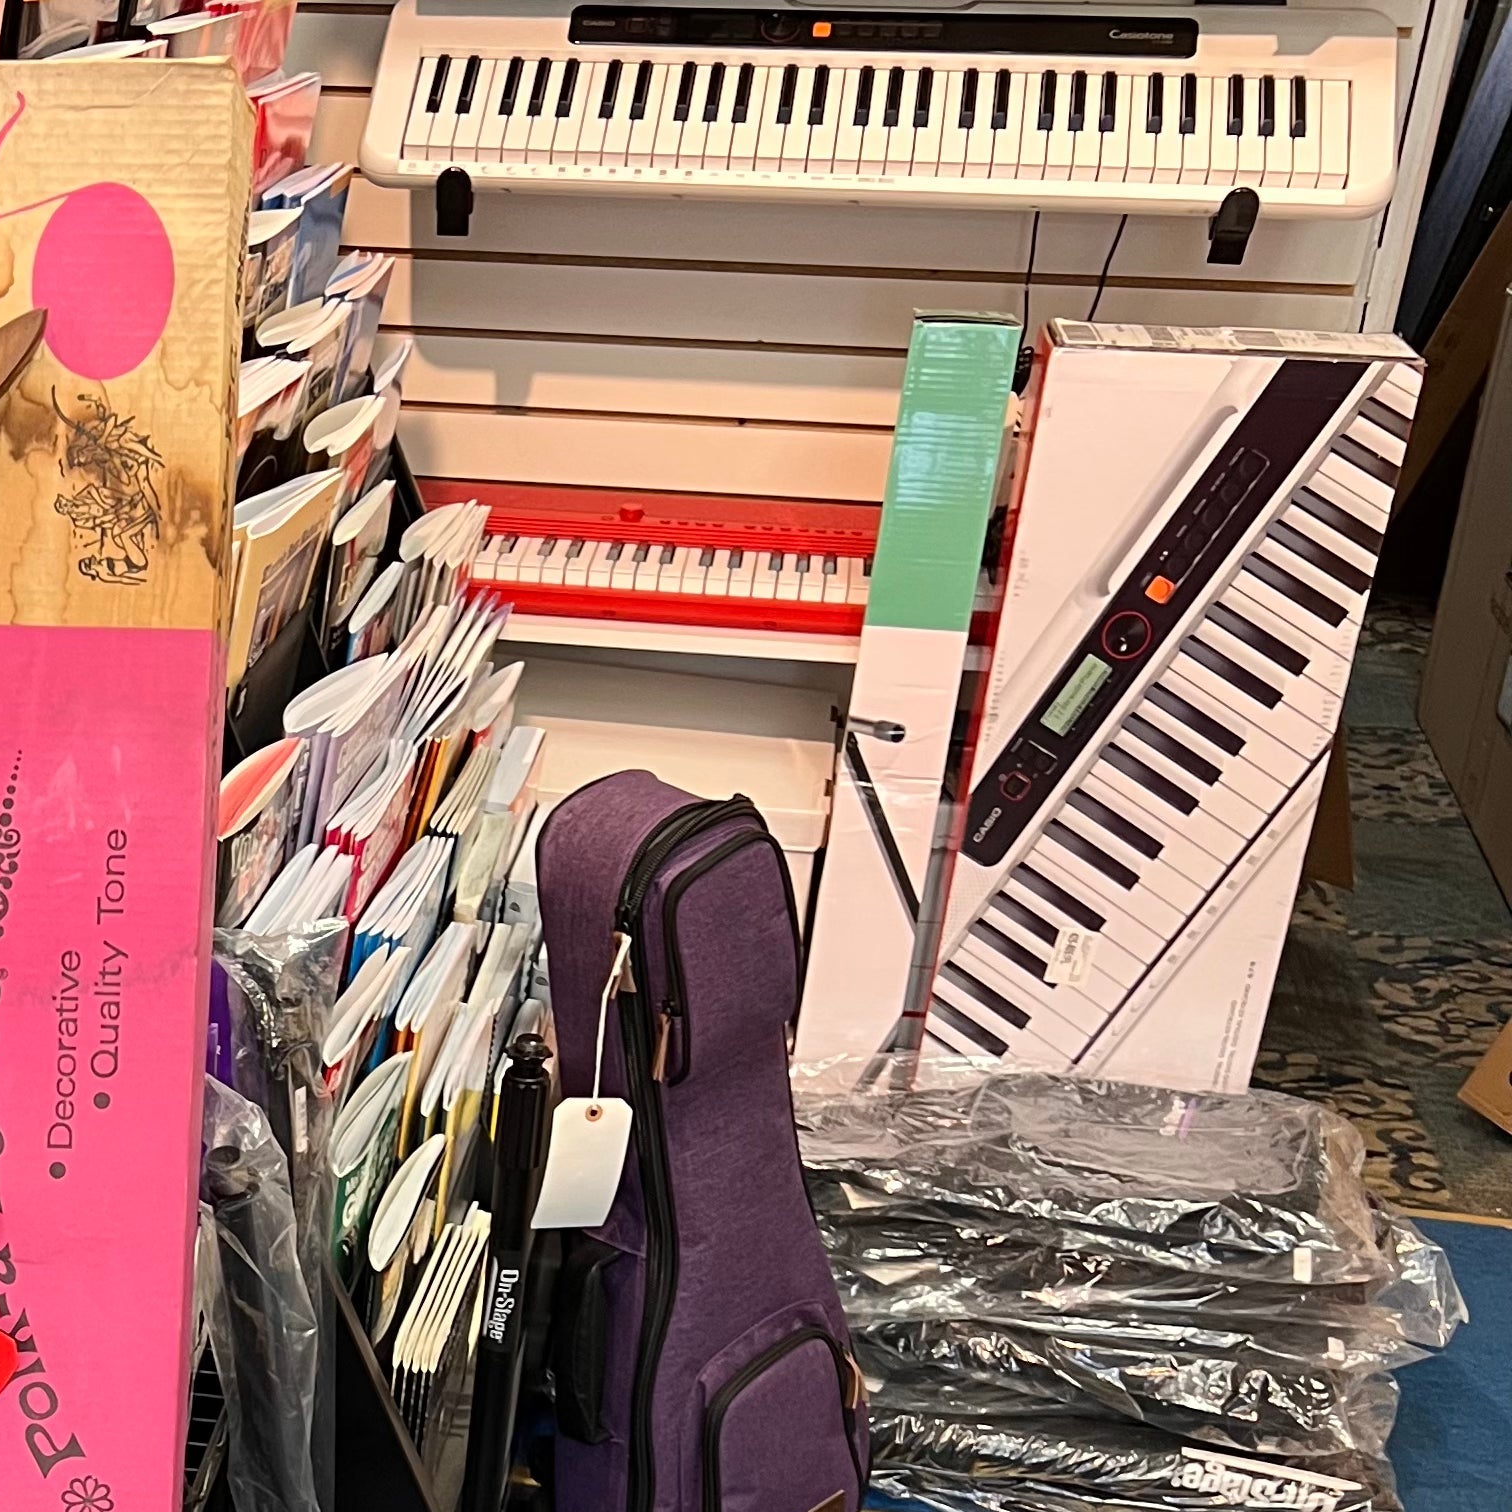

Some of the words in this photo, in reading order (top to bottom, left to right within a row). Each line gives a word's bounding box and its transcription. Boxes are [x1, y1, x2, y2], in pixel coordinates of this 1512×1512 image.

[1108, 29, 1174, 40] Casiotone
[972, 807, 1002, 843] CASIO
[96, 828, 128, 926] Tone
[46, 949, 82, 1150] Decorative
[90, 940, 129, 1079] Quality
[488, 1268, 520, 1344] On-Stage
